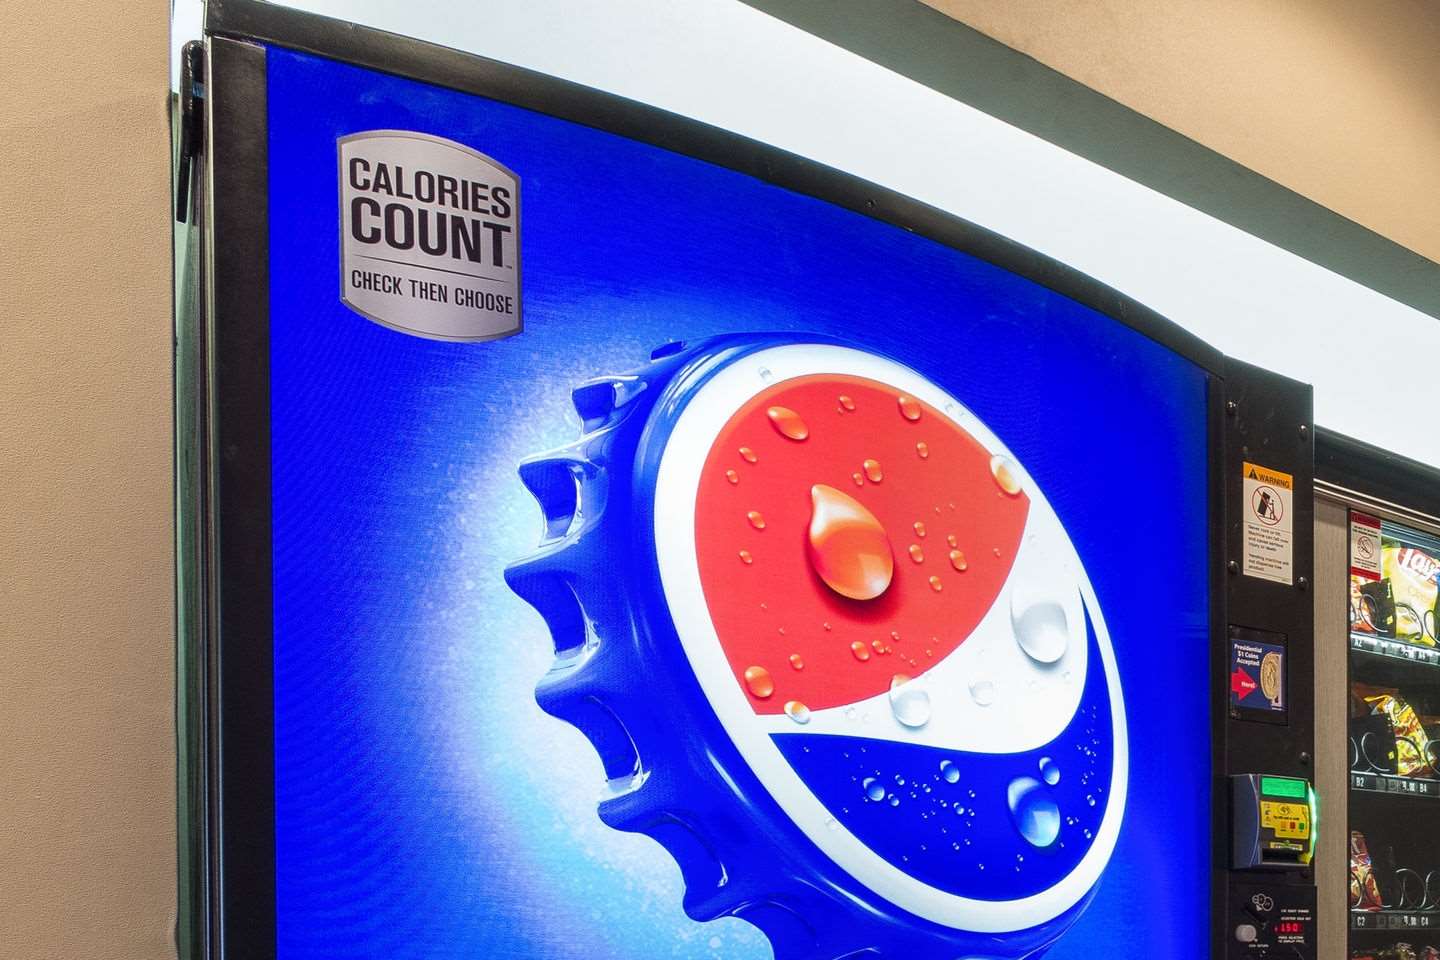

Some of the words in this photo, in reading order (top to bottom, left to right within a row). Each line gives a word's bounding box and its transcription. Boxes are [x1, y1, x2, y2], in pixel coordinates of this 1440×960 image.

[350, 157, 511, 219] CALORIES
[351, 196, 511, 269] COUNT
[351, 270, 403, 296] CHECK
[408, 279, 448, 303] THEN
[454, 287, 513, 315] CHOOSE
[1258, 473, 1290, 489] WARNING
